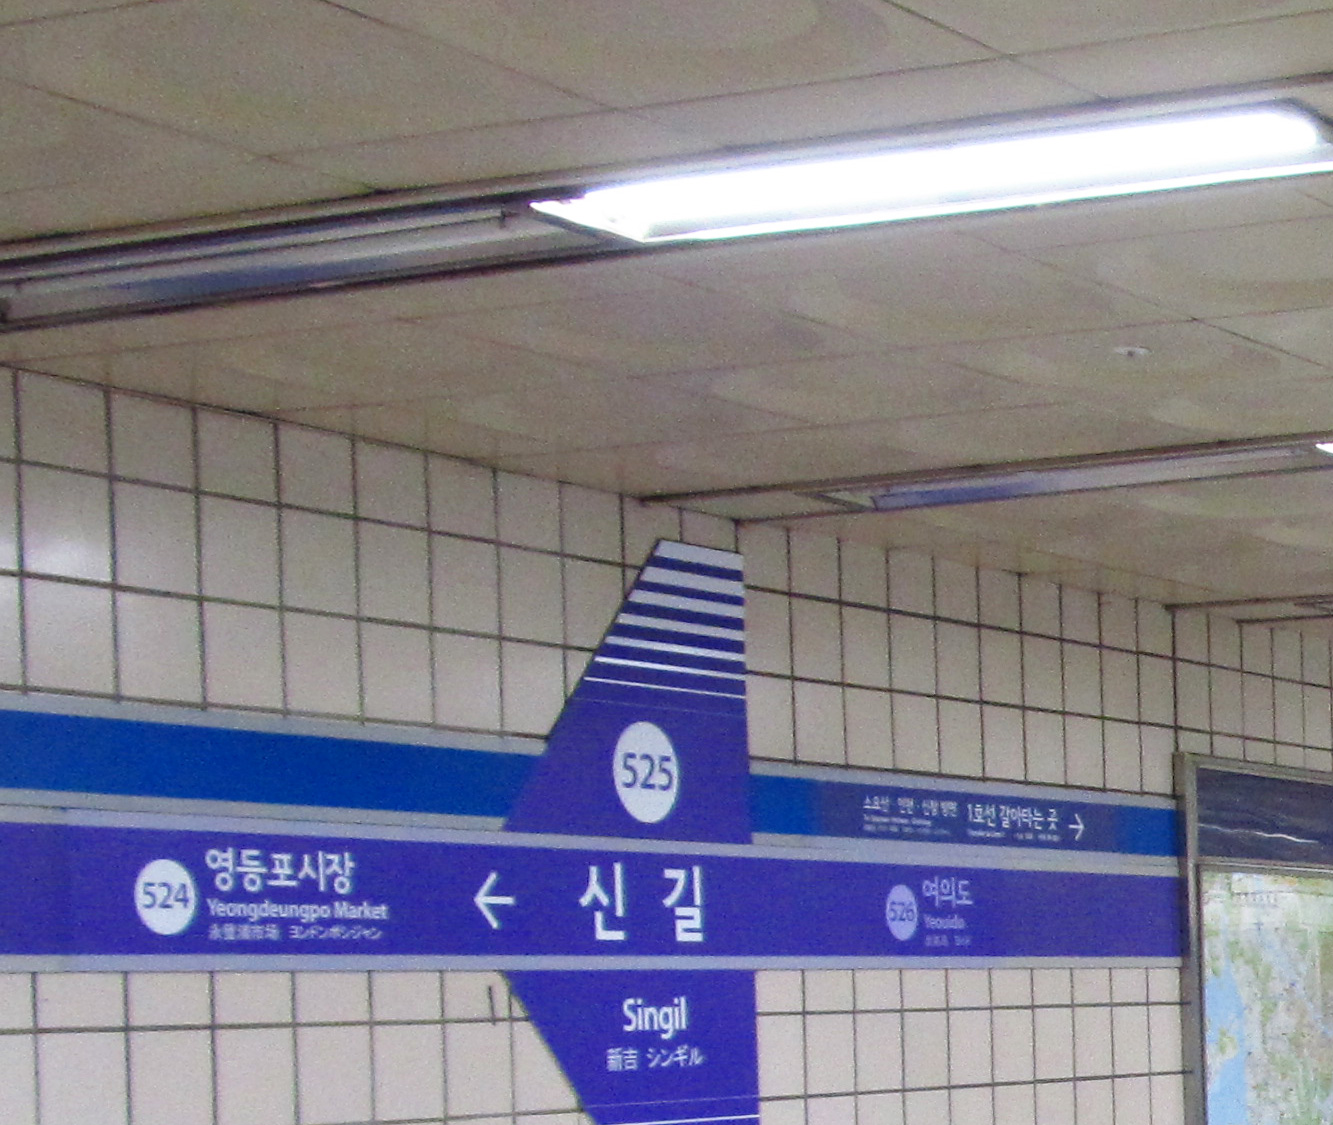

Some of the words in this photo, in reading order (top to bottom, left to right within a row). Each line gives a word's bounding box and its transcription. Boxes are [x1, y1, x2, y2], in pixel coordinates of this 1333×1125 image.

[621, 752, 673, 791] 525
[967, 803, 996, 828] 1호선
[999, 805, 1043, 831] 갈아타는
[1047, 808, 1058, 831] 곳
[205, 847, 356, 895] 영등포시장
[142, 882, 190, 910] 524
[922, 876, 974, 908] 여의도
[206, 898, 331, 923] Yeongdeungpo
[333, 901, 388, 920] Market
[622, 995, 688, 1040] Singil
